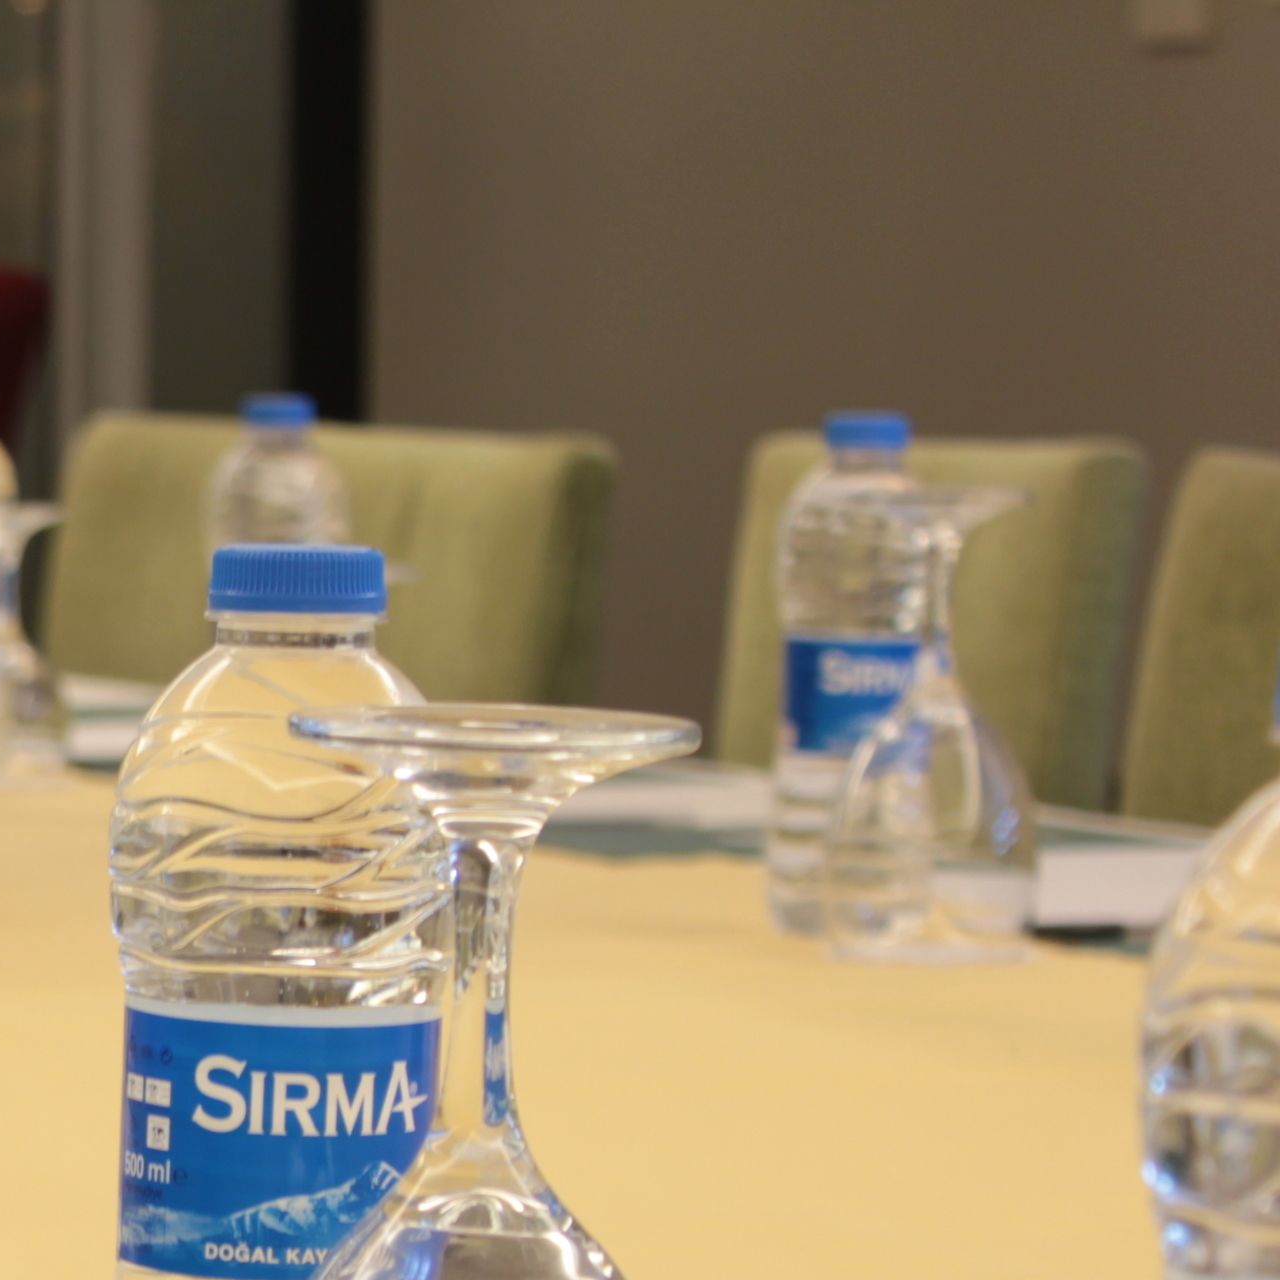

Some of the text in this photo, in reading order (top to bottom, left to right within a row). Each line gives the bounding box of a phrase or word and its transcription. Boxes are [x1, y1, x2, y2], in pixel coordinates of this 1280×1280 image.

[192, 1054, 428, 1137] SIRMA
[125, 1150, 171, 1184] 500 ml
[204, 1240, 328, 1264] DOĞAL KAY
